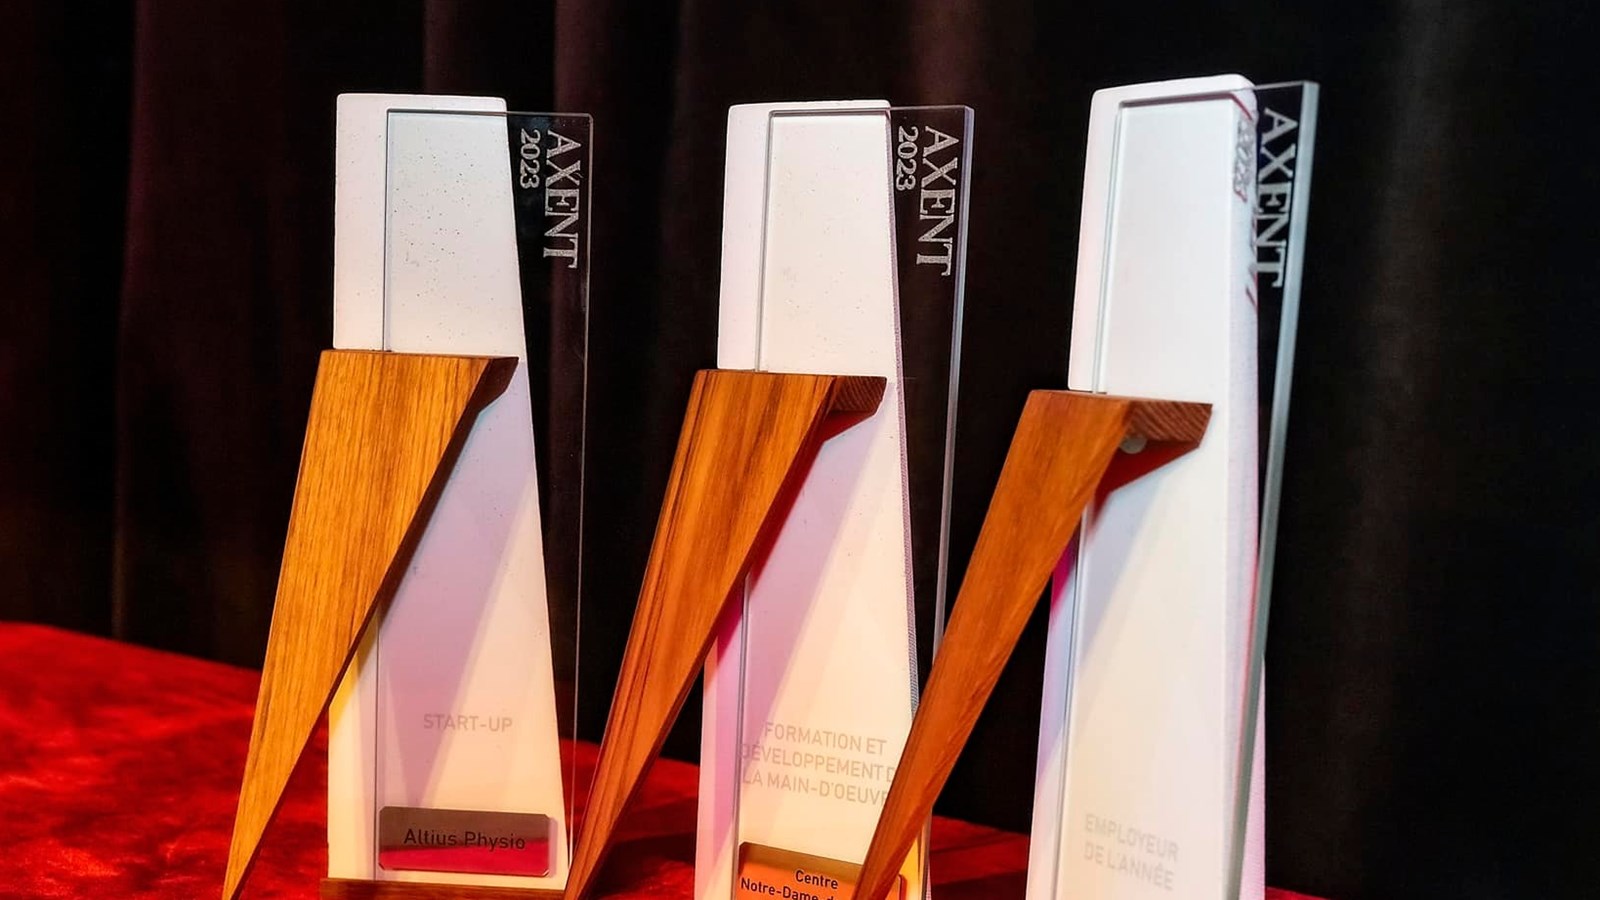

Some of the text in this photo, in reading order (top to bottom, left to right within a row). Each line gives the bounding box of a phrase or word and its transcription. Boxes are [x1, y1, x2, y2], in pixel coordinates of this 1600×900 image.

[519, 128, 541, 189] 2023
[895, 125, 919, 191] 2023
[543, 130, 582, 269] AXENT
[916, 125, 960, 277] AXENT
[1250, 107, 1298, 288] AXENT
[423, 713, 513, 733] START-UP
[765, 722, 888, 757] FORMATION ET
[742, 768, 763, 787] LA
[403, 828, 526, 852] Altius Physio
[1085, 813, 1179, 863] EMPLOYEUR
[795, 869, 839, 890] Centre
[1083, 841, 1175, 891] DE L'ANNÉE
